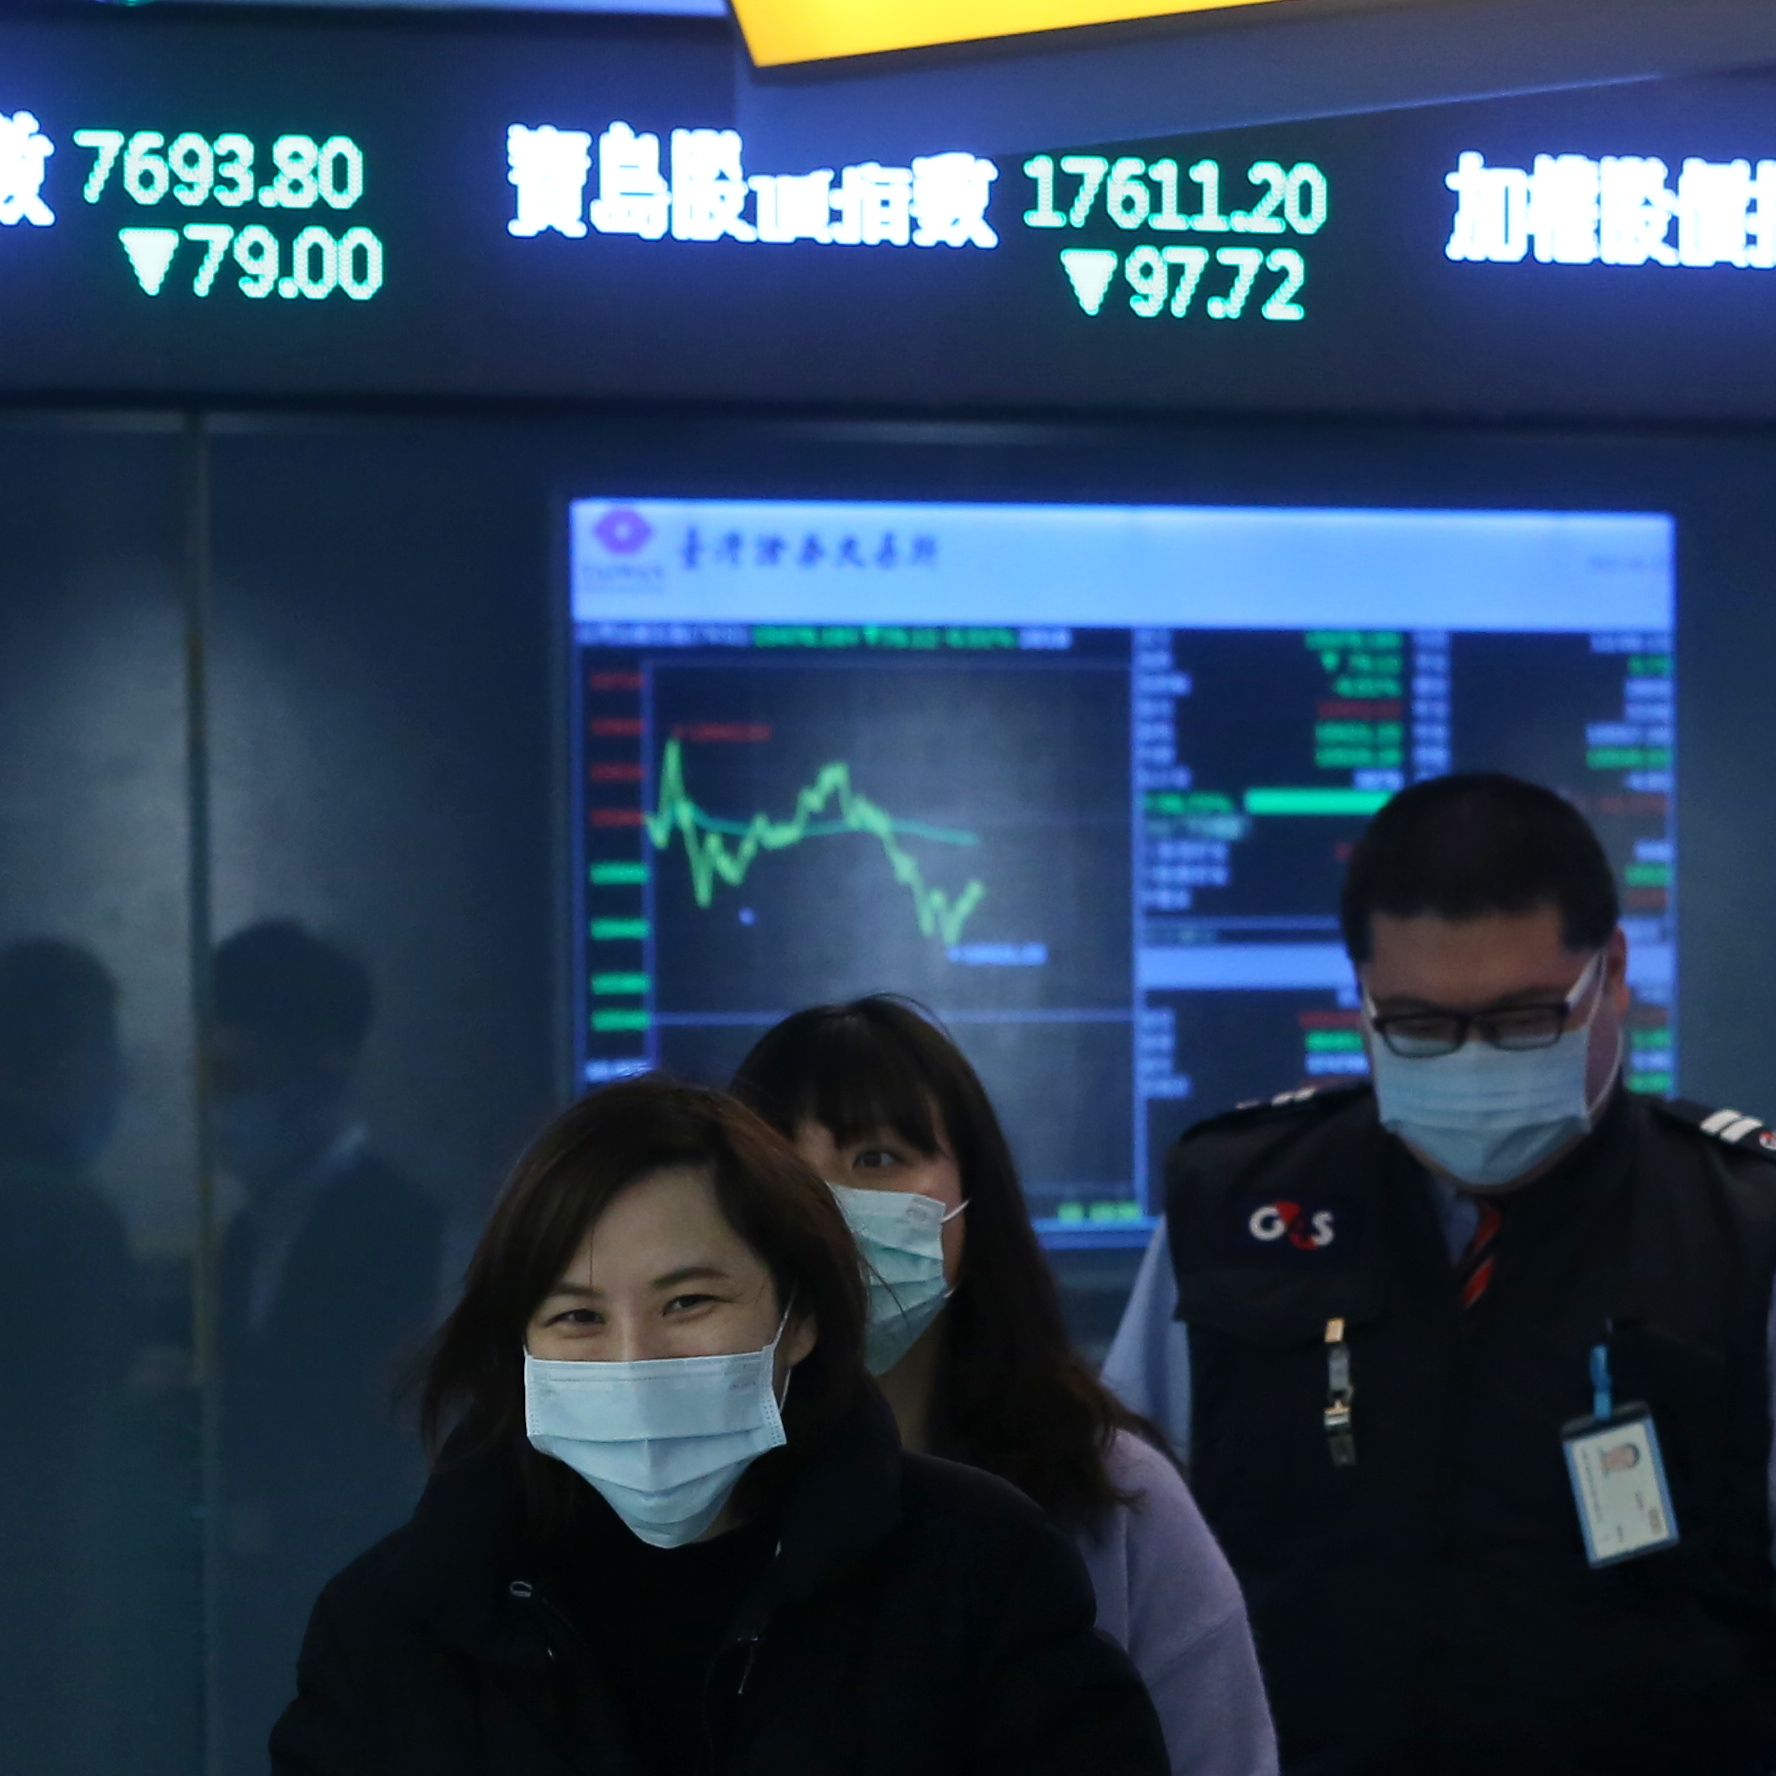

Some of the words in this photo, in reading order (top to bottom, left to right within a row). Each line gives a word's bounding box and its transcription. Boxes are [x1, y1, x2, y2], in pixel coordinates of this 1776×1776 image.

[73, 129, 364, 210] 7693.80
[1024, 155, 1328, 235] 17611.20
[182, 223, 384, 301] 79.00
[1125, 245, 1305, 321] 97.72
